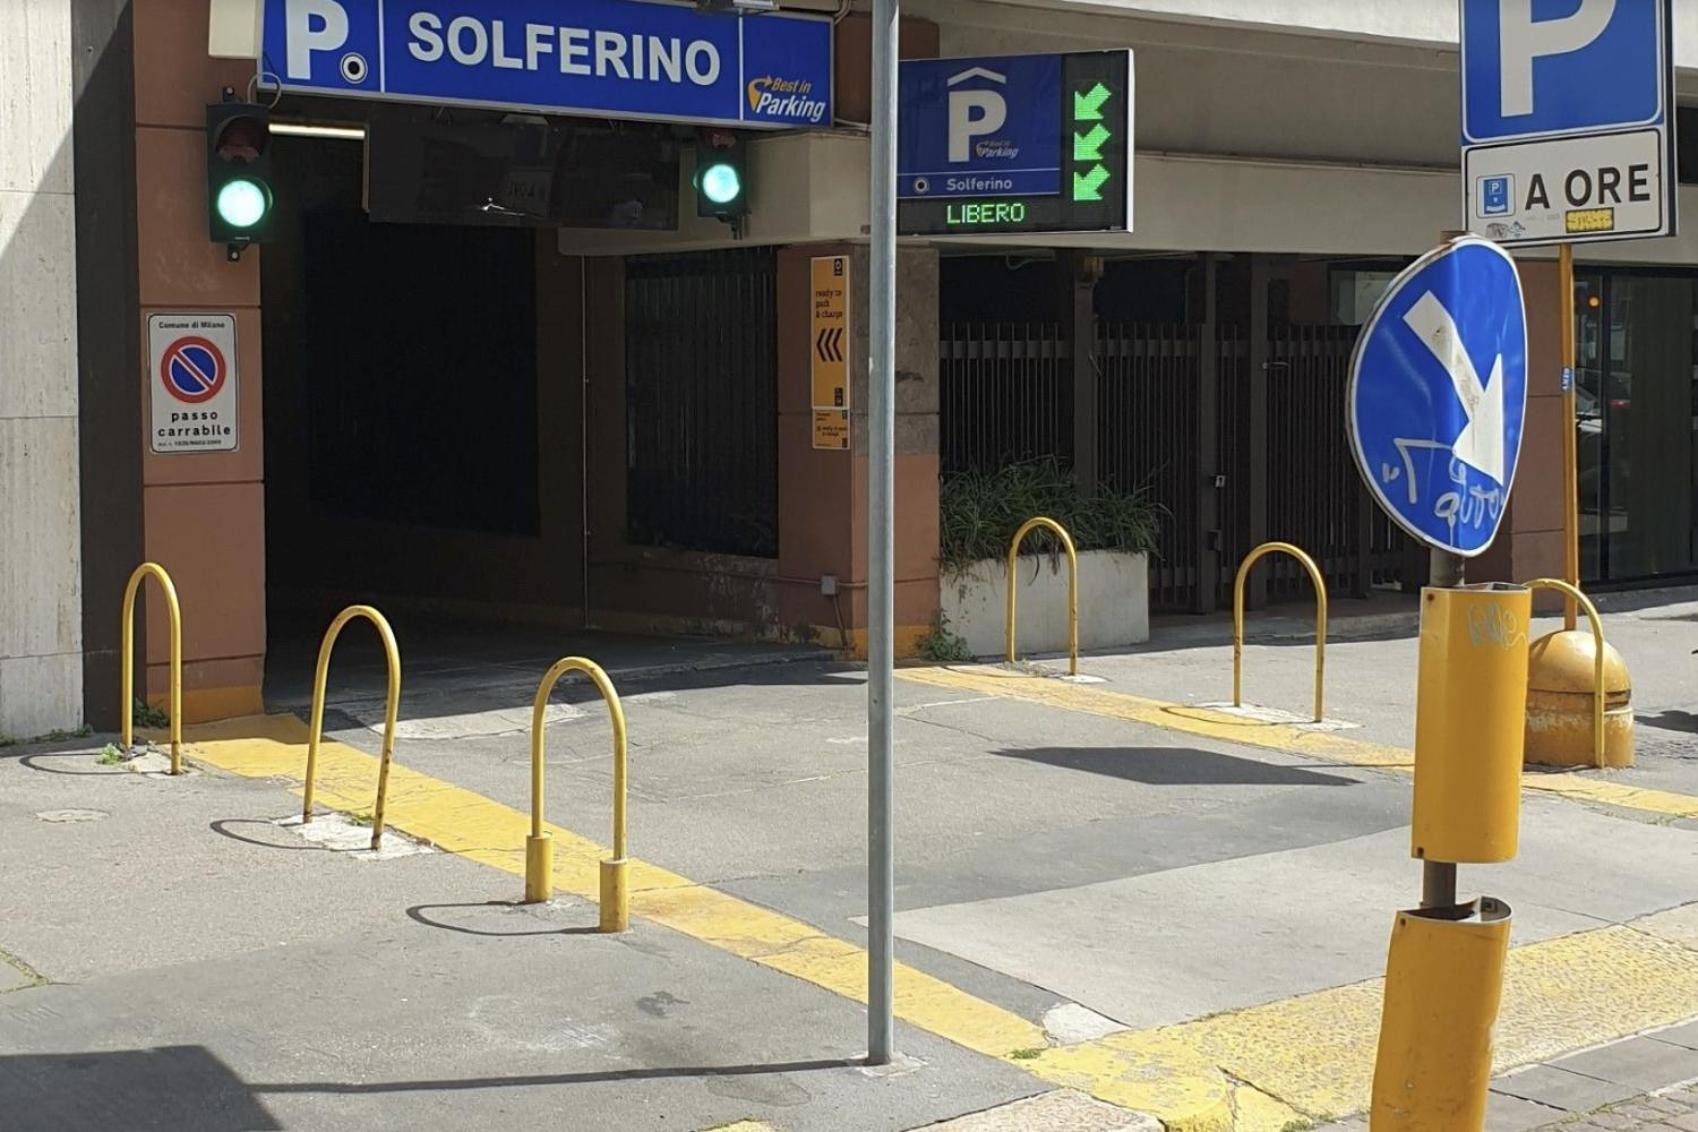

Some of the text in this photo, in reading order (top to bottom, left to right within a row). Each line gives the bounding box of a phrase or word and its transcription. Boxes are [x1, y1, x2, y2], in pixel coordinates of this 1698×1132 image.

[285, 0, 350, 80] P
[407, 11, 721, 86] SOLFERINO
[1499, 0, 1617, 118] P
[771, 76, 812, 94] Best in
[756, 92, 827, 123] Parking
[948, 91, 1007, 162] P
[946, 177, 1013, 192] Solferino
[1525, 163, 1651, 211] A ORE
[946, 203, 1025, 224] LIBERO
[157, 424, 231, 437] carrabile
[171, 411, 219, 424] passo
